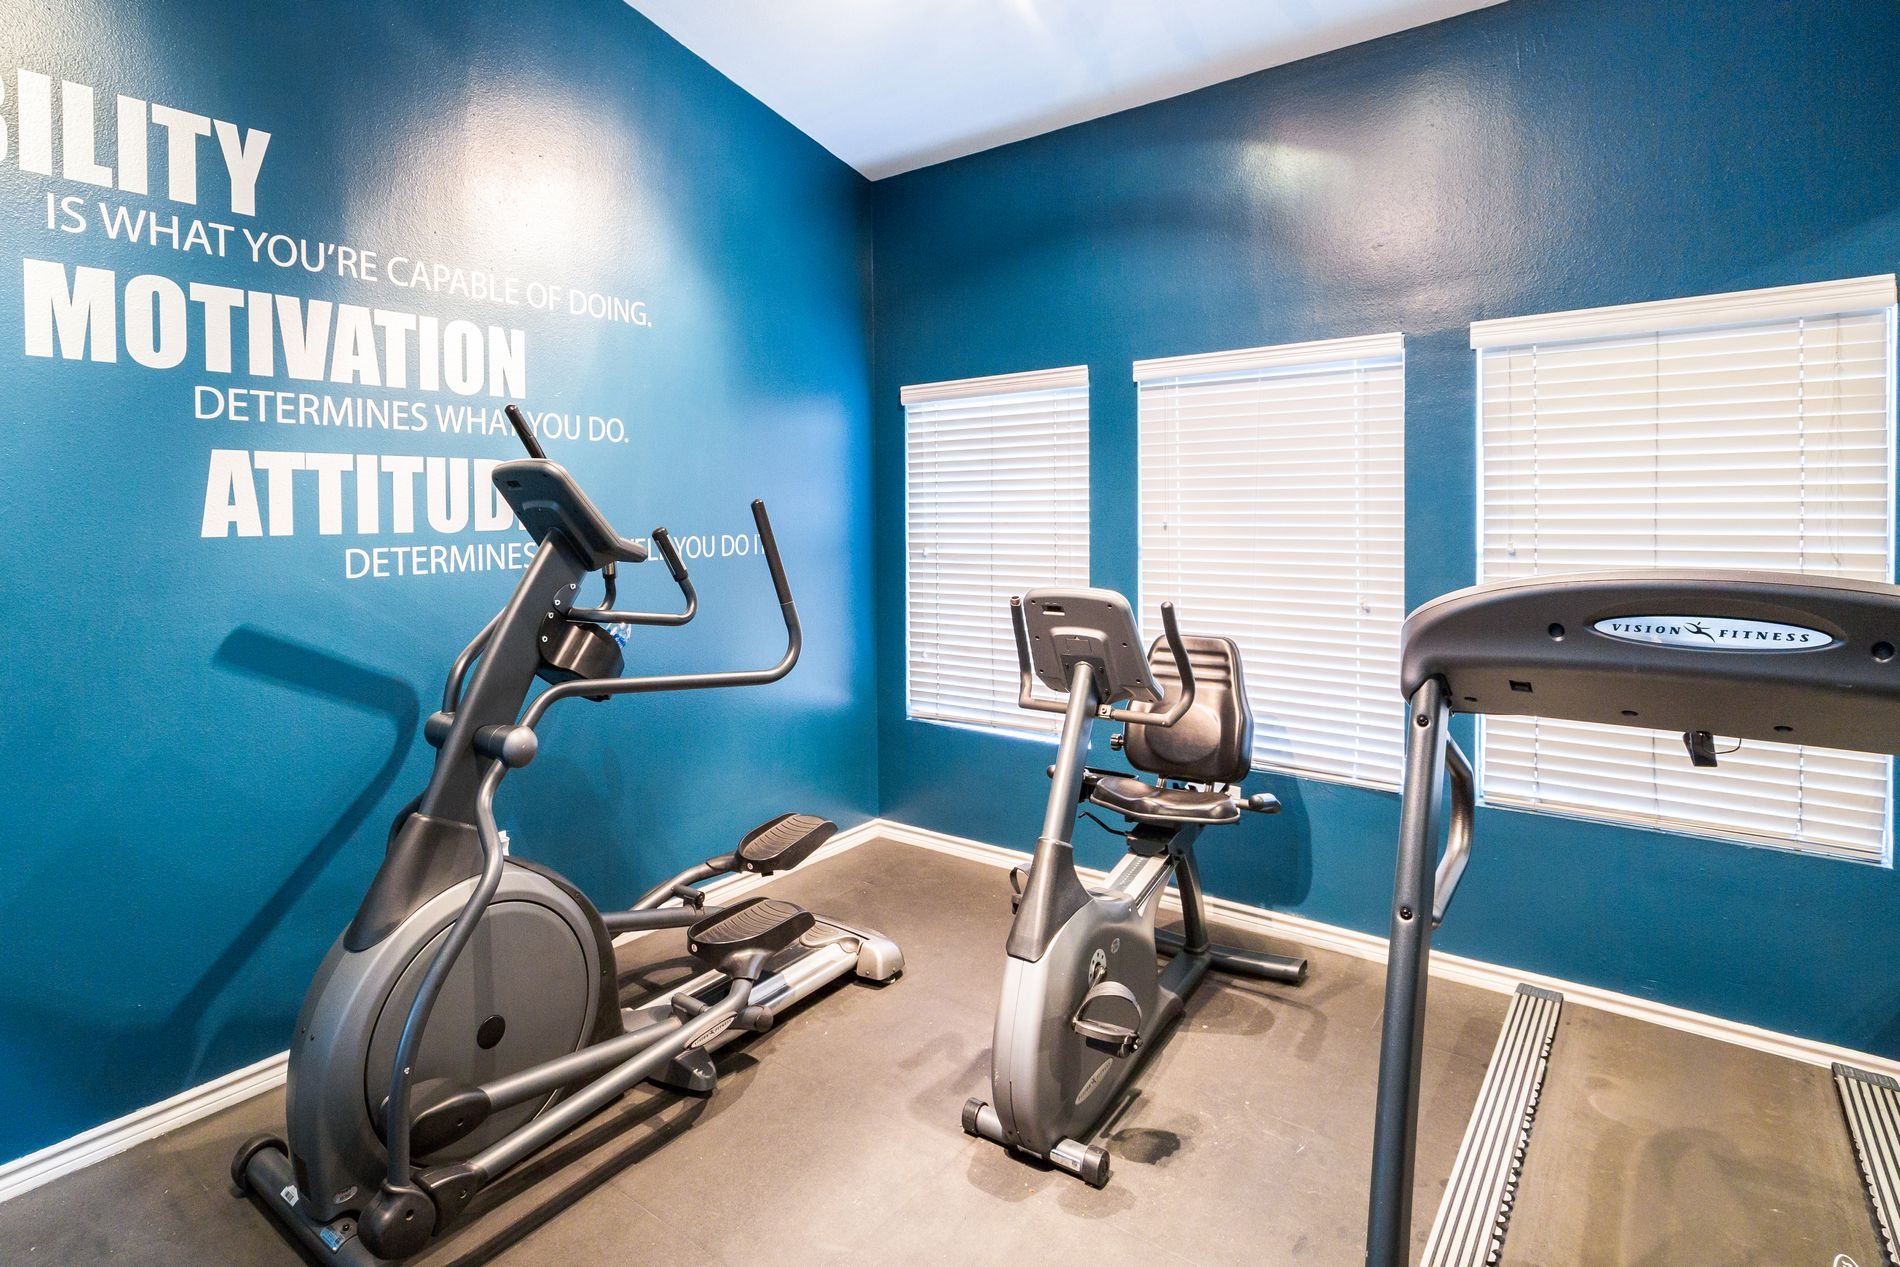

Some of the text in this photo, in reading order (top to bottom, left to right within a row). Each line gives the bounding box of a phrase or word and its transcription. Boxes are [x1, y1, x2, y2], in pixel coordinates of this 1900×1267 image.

[0, 68, 272, 217] ILITY
[47, 192, 87, 234] IS
[99, 202, 235, 257] WHAT
[387, 256, 519, 306] CAPABLE
[526, 281, 562, 312] OF
[569, 289, 653, 328] DOING.
[23, 257, 527, 399] MOTIVATION
[194, 386, 630, 443] DETERMINES WHA YOU DO.
[201, 449, 527, 538] ATTITUD
[345, 541, 536, 578] DETERMINES
[674, 536, 715, 559] YOU
[721, 534, 749, 557] DO
[754, 533, 765, 555] I
[1612, 623, 1811, 643] VISION FITNESS
